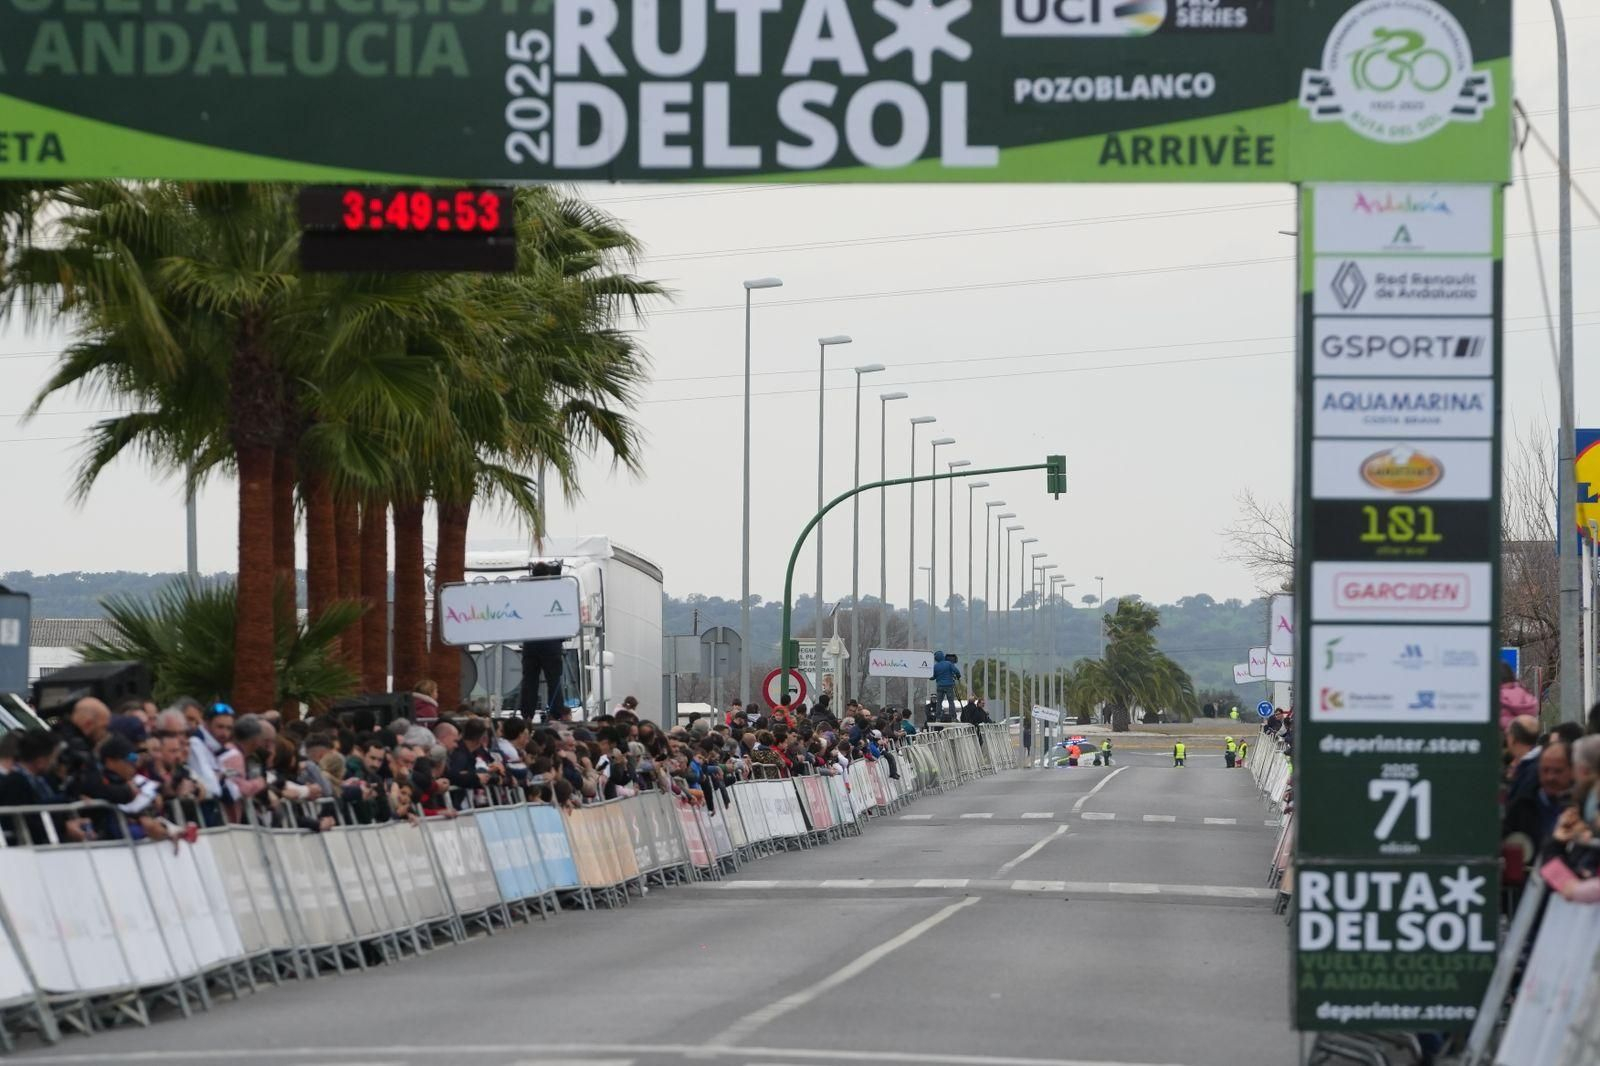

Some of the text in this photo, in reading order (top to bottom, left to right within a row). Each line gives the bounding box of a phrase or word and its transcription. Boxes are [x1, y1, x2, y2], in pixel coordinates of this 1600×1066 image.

[1014, 0, 1101, 24] UCI
[1176, 7, 1248, 28] SERIES
[25, 8, 470, 77] ANDALUCÍA
[553, 0, 869, 77] RUTA
[505, 28, 551, 164] 2025
[1014, 72, 1216, 103] POZOBLANCO
[553, 80, 999, 168] DEL SOL
[1098, 126, 1275, 166] ARRIVÈE
[342, 190, 500, 231] 3:49:53
[1353, 189, 1452, 216] Andalucía
[1375, 272, 1476, 286] Red Renault
[1375, 287, 1395, 299] de
[1321, 335, 1454, 358] GSPORT
[1322, 391, 1483, 412] AQUAMARINA
[1343, 582, 1460, 601] GARCIDEN
[445, 602, 523, 624] Andalucía
[1319, 735, 1481, 757] deporinter.store
[1368, 779, 1431, 841] 71
[1299, 871, 1439, 911] RUTA
[1299, 911, 1496, 952] DEL SOL
[1300, 954, 1494, 970] VUELTA CICLISTA
[1300, 972, 1318, 989] A
[1316, 1001, 1477, 1023] deporinter.store
